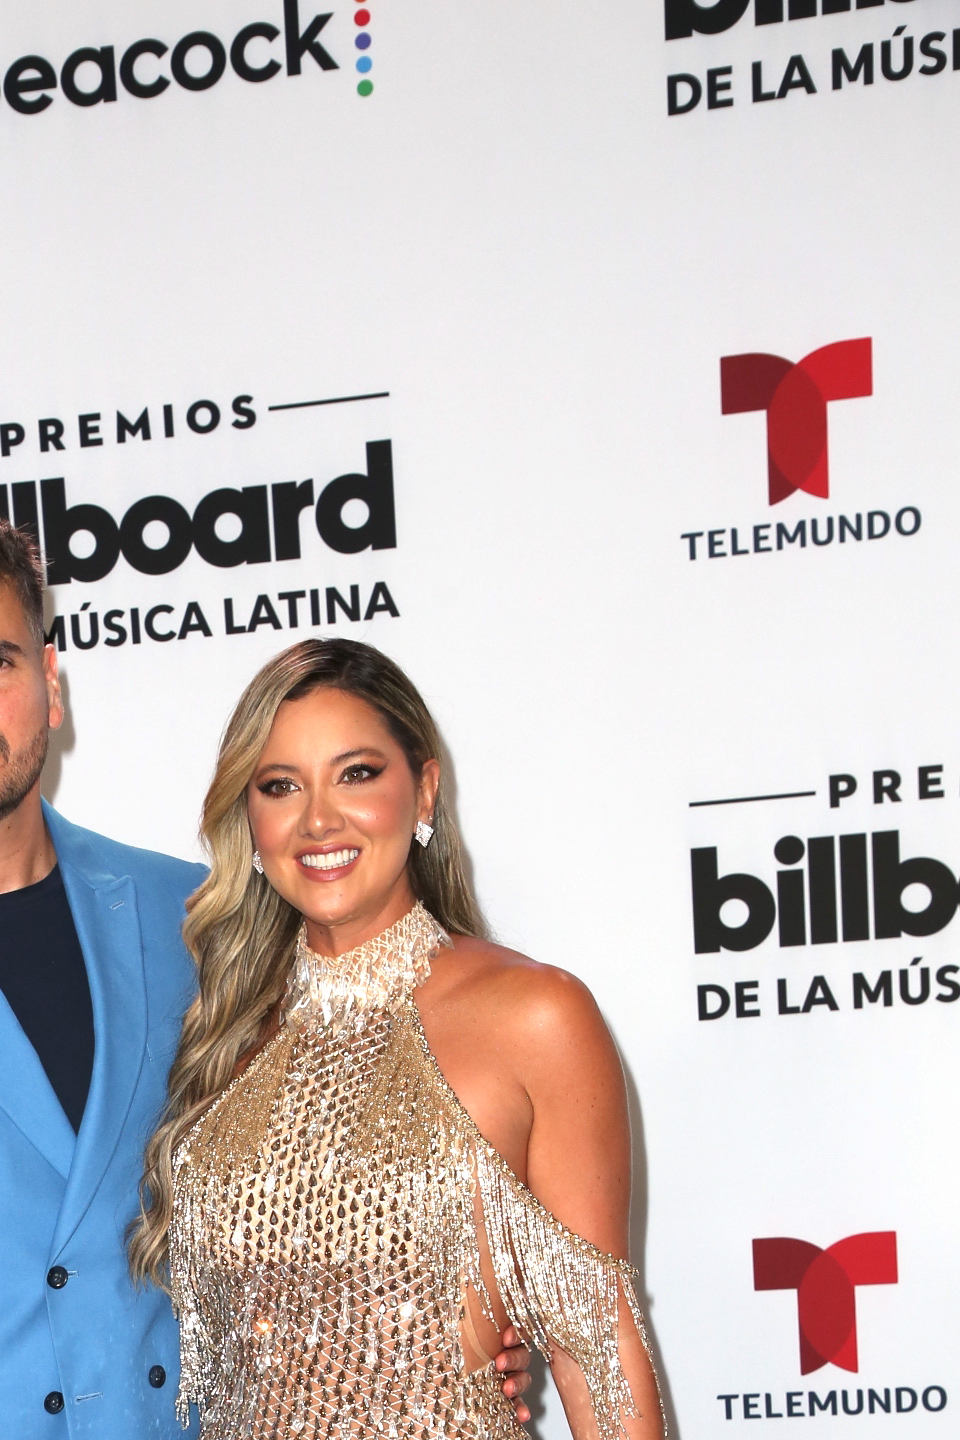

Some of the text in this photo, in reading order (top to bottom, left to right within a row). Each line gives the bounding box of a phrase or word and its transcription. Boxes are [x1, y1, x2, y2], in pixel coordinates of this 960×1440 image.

[667, 65, 734, 116] DE
[751, 54, 817, 103] LA
[0, 395, 257, 457] PREMIOS
[681, 505, 922, 561] TELEMUNDO
[223, 581, 400, 635] LATINA
[697, 980, 761, 1021] DE
[777, 975, 839, 1015] LA
[717, 1385, 947, 1420] TELEMUNDO
